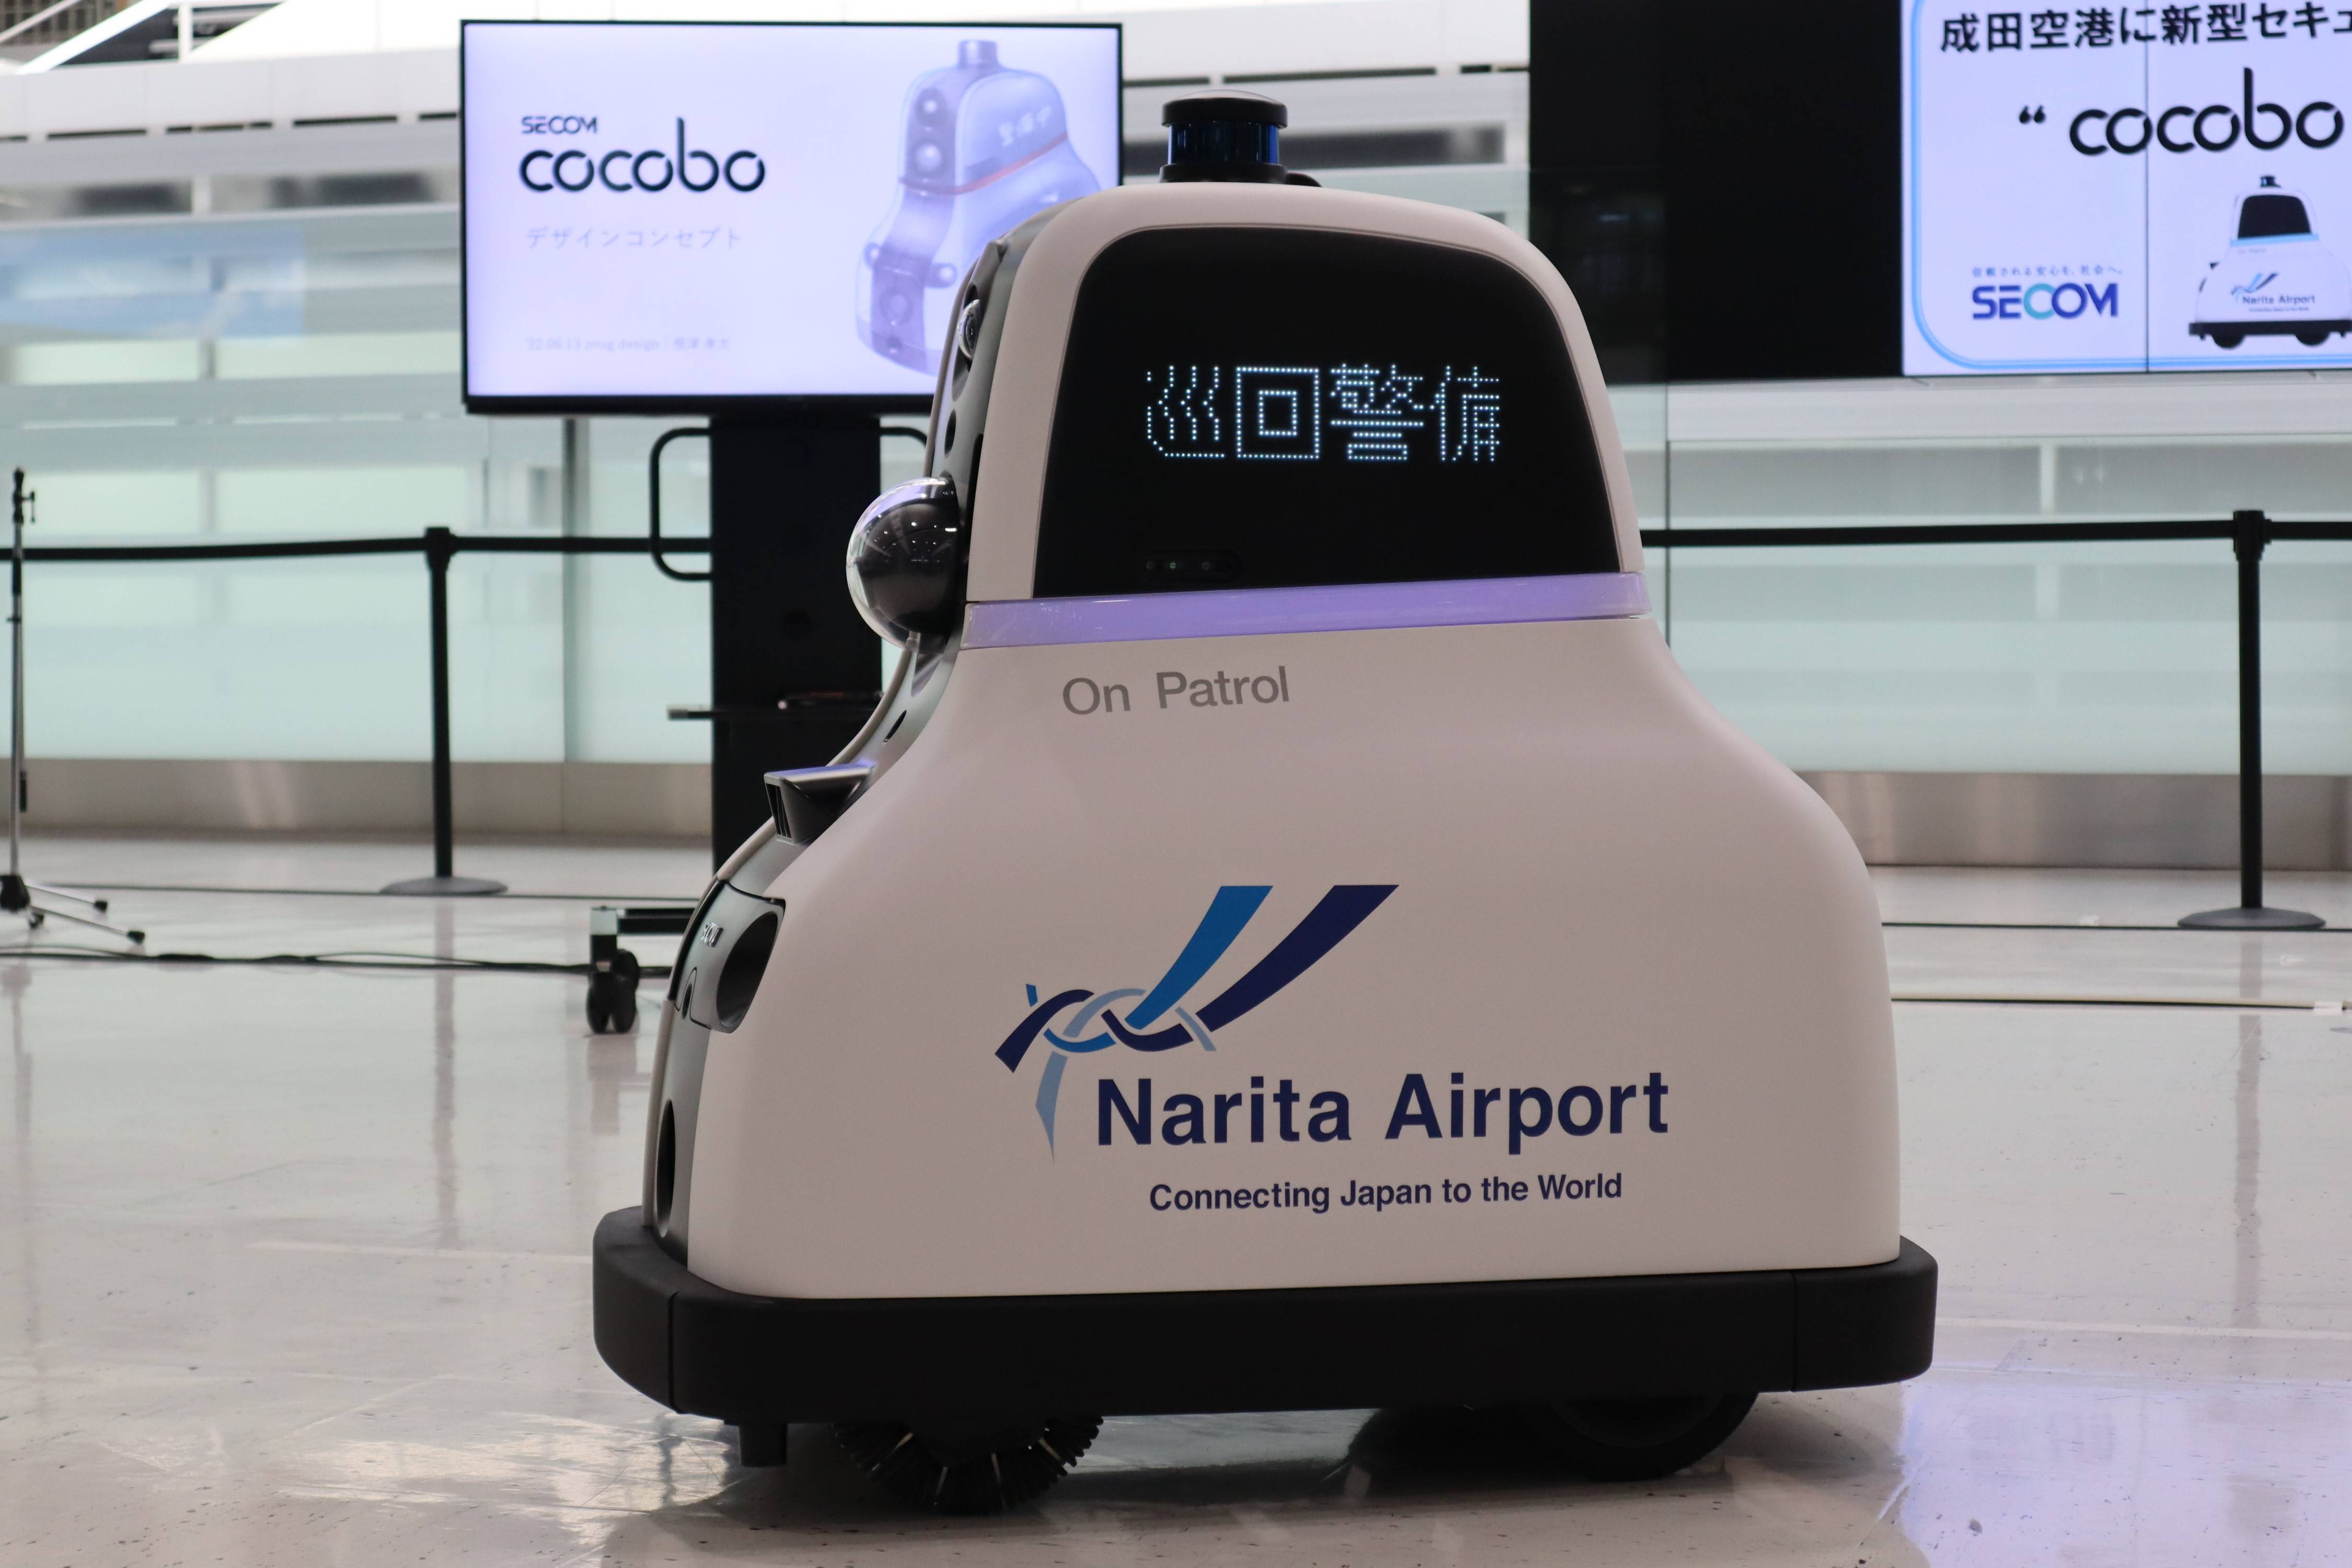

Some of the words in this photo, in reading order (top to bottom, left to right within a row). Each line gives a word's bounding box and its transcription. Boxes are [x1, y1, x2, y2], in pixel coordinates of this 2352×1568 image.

[522, 116, 598, 135] SECOM
[2069, 67, 2345, 156] cocobo
[518, 117, 766, 193] cocobo
[526, 226, 740, 249] デザインコンセプト
[1972, 282, 2119, 320] SECOM
[1146, 362, 1501, 463] 巡回警備
[1063, 677, 1131, 715] On
[1156, 666, 1289, 709] Patrol
[1098, 1076, 1352, 1146] Narita
[1385, 1072, 1668, 1155] Airport
[1149, 1182, 1330, 1214] Connecting
[1340, 1180, 1432, 1212] Japan
[1442, 1179, 1472, 1203] to
[1481, 1175, 1529, 1202] the
[1537, 1172, 1622, 1200] World
